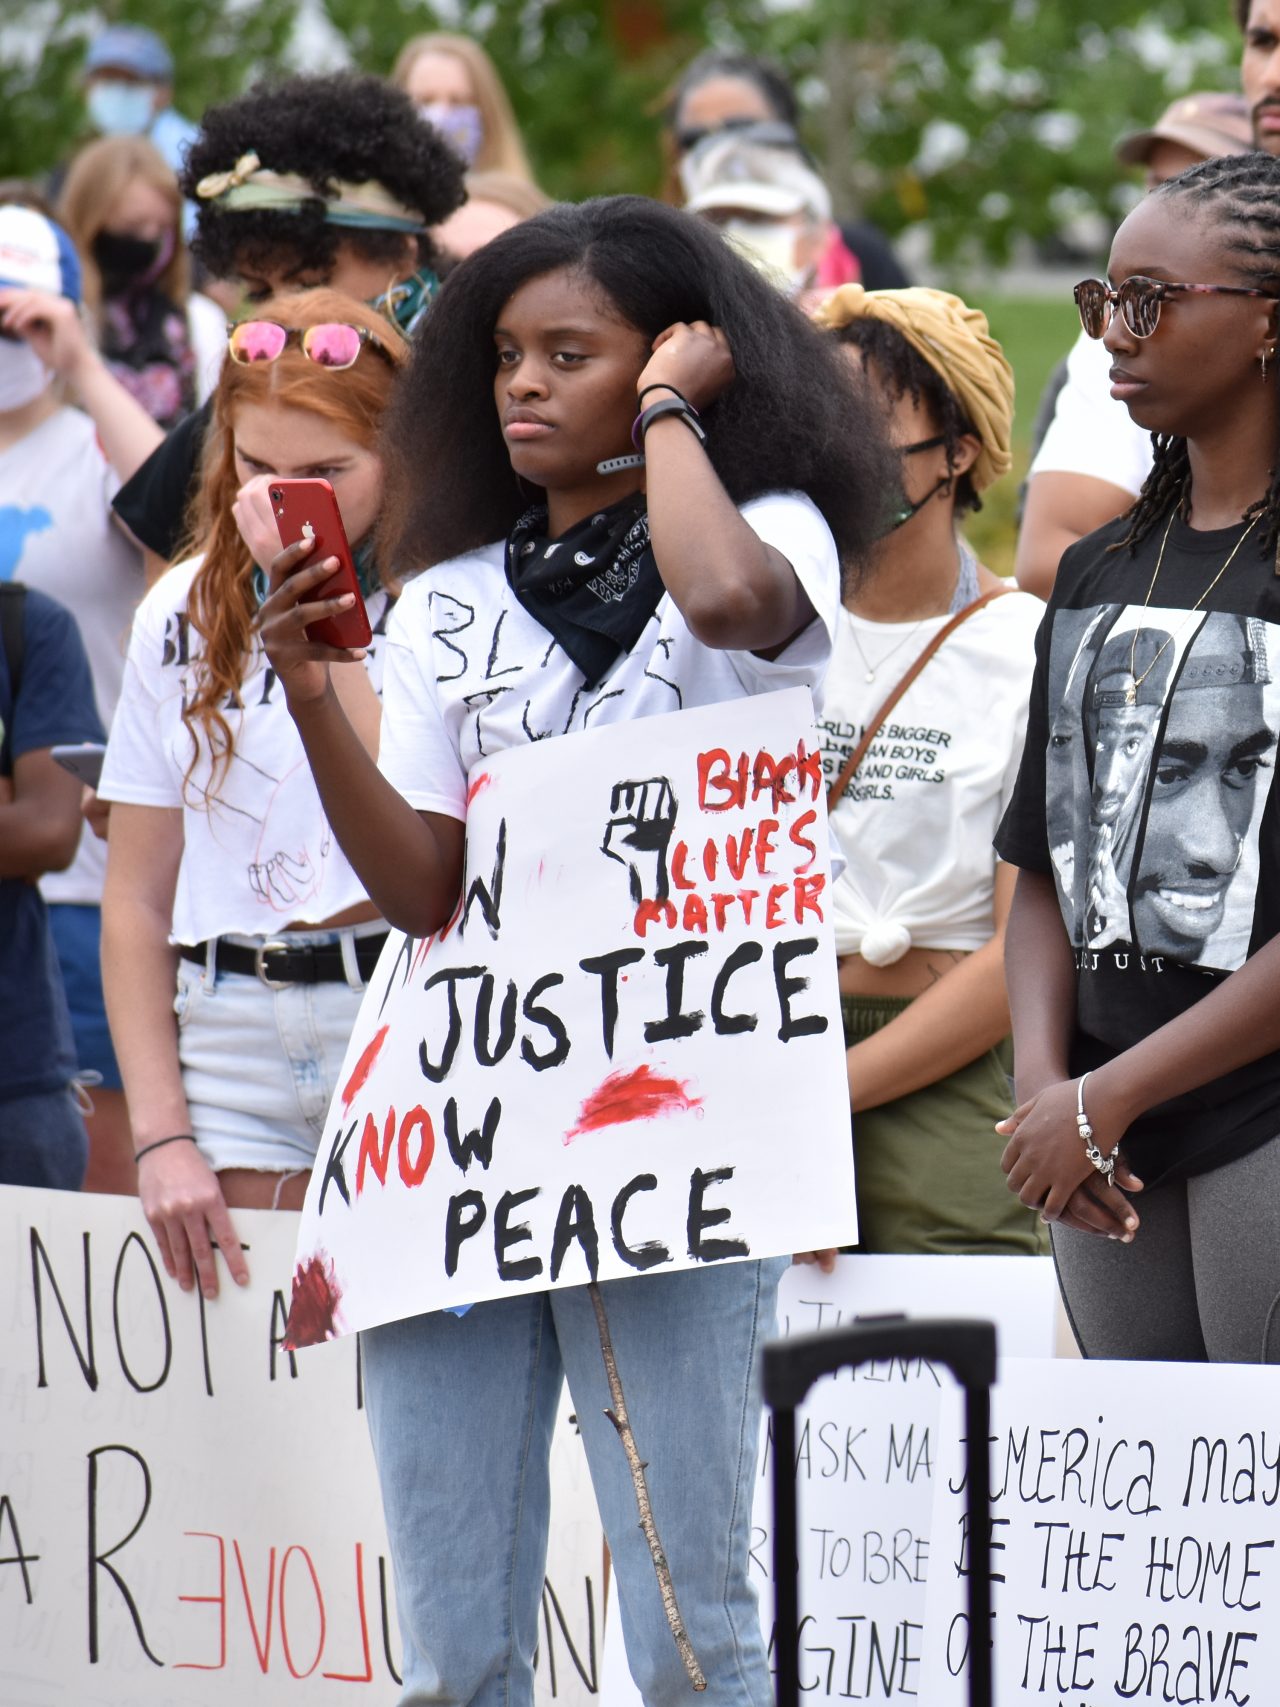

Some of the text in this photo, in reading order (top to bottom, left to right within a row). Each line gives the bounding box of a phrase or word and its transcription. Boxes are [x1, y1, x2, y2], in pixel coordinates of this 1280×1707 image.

[866, 764, 893, 778] AND
[895, 765, 945, 783] GIRLS
[887, 724, 952, 748] BIGGER
[890, 745, 937, 764] BOYS
[671, 809, 817, 890] LIVES
[633, 873, 827, 938] MATTER
[418, 938, 829, 1084] JUSTICE
[318, 1096, 501, 1216] KNOW
[444, 1166, 751, 1283] PEACE
[30, 1226, 251, 1397] NOT
[810, 1528, 851, 1579] TO
[1034, 1521, 1125, 1592] THE
[1146, 1536, 1276, 1612] HOME
[1017, 1613, 1099, 1692] THE
